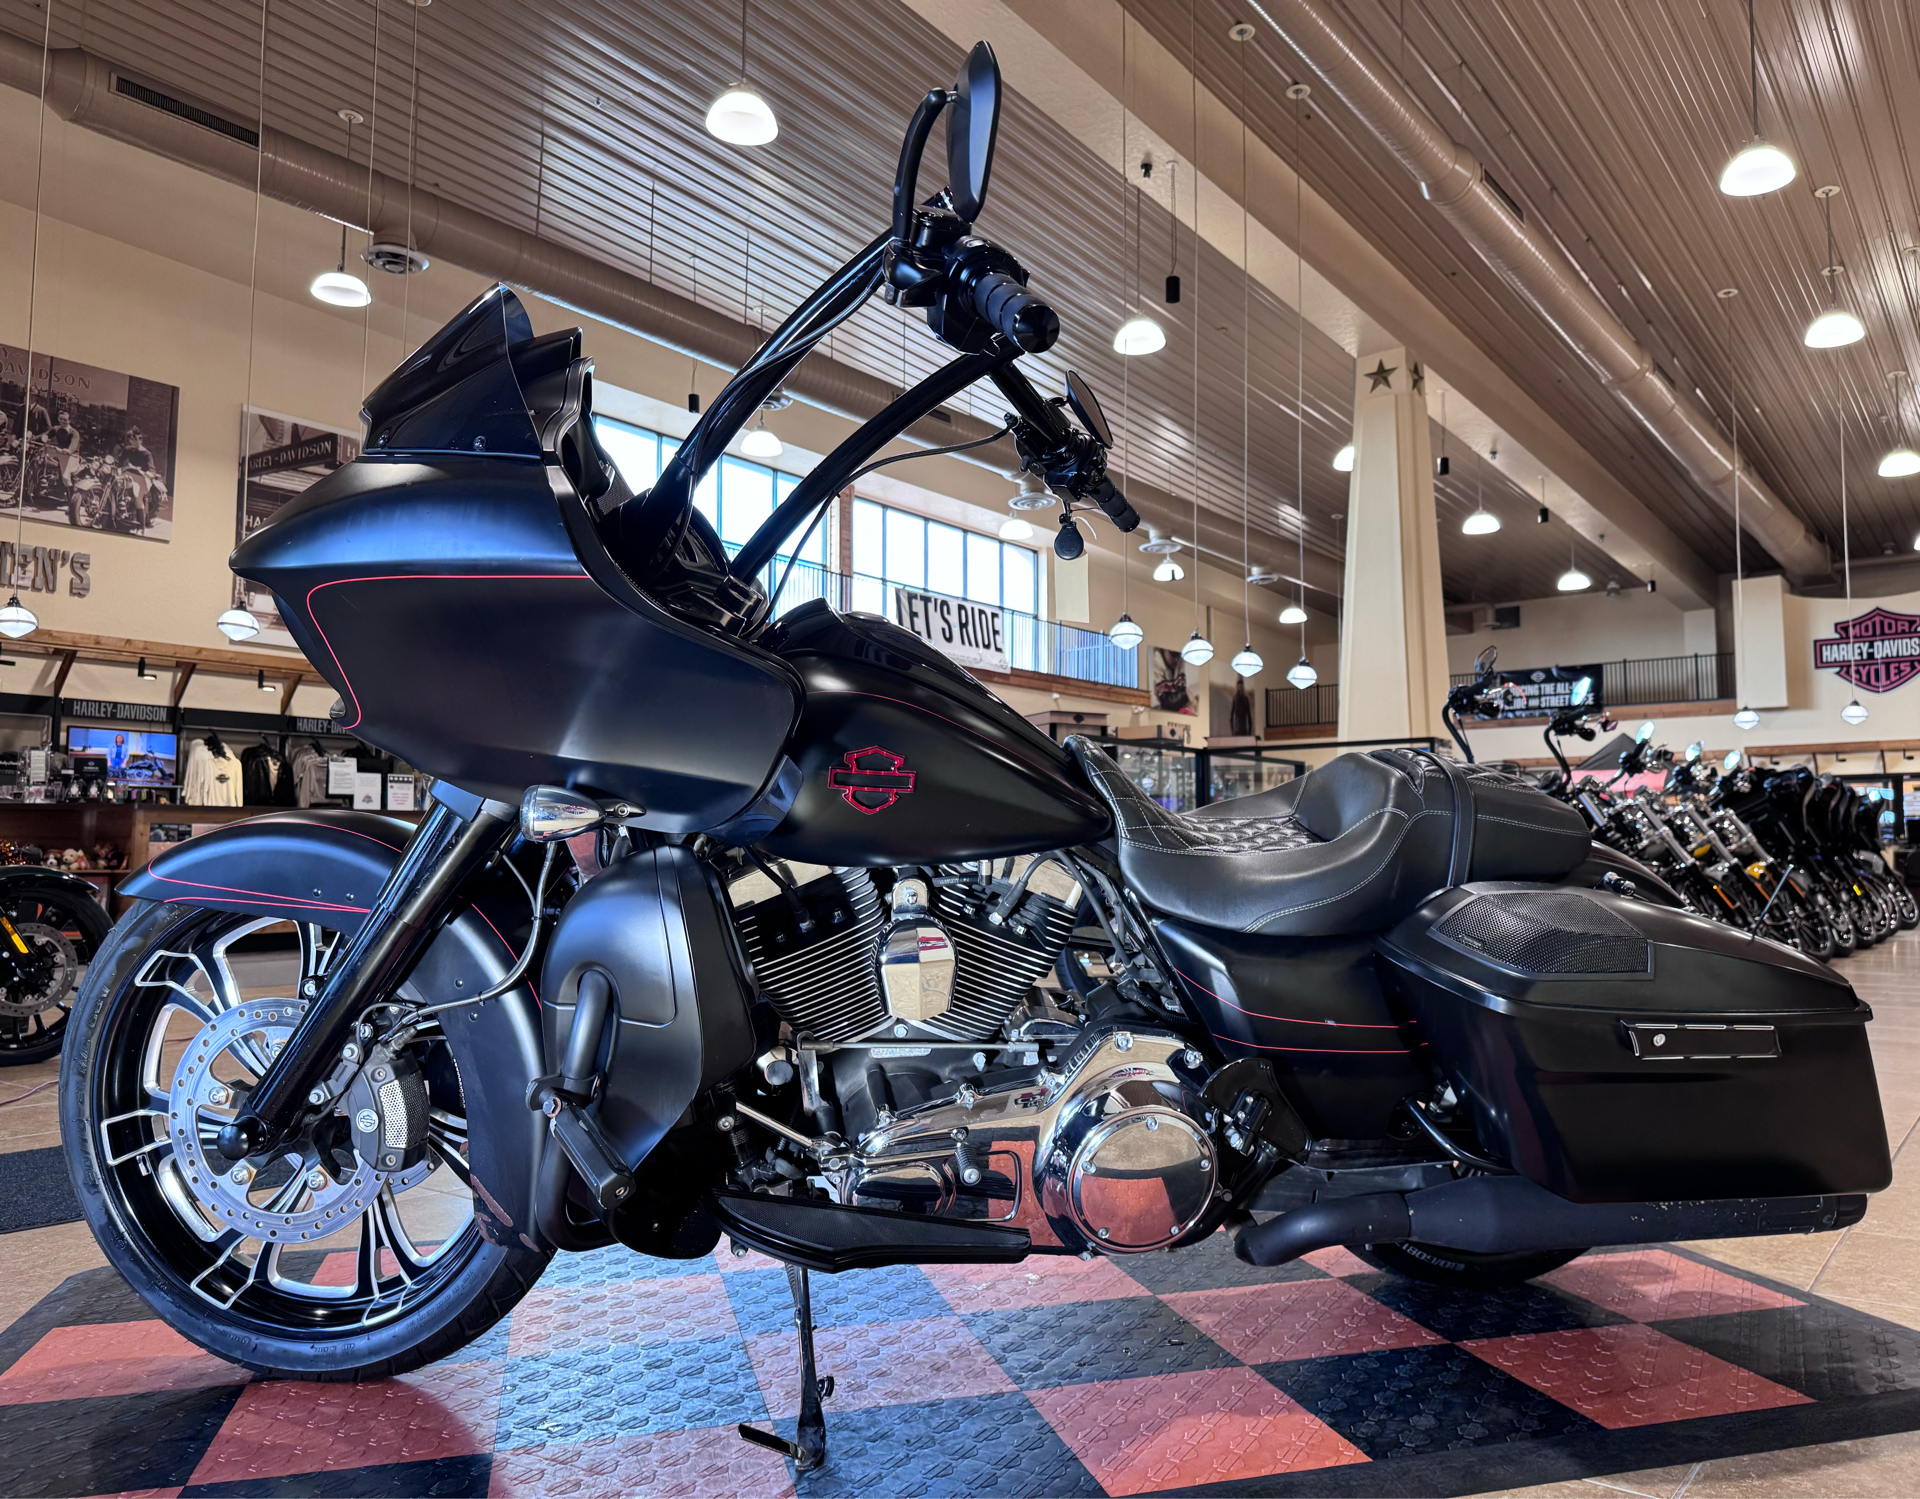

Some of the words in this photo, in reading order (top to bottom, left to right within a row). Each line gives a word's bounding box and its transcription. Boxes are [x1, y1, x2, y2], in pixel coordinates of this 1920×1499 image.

[0, 361, 91, 390] AVIDSON
[247, 440, 332, 471] ARLEY-DAVIDSON
[896, 587, 953, 644] LET'S
[957, 603, 1003, 653] RIDE
[1848, 616, 1910, 638] MOTOR
[1849, 662, 1911, 686] CYCLES
[1541, 682, 1556, 695] THE
[73, 701, 168, 722] HARLEY-DAVIDSON
[1540, 695, 1570, 708] STREET
[296, 717, 350, 735] HARLEY-DA
